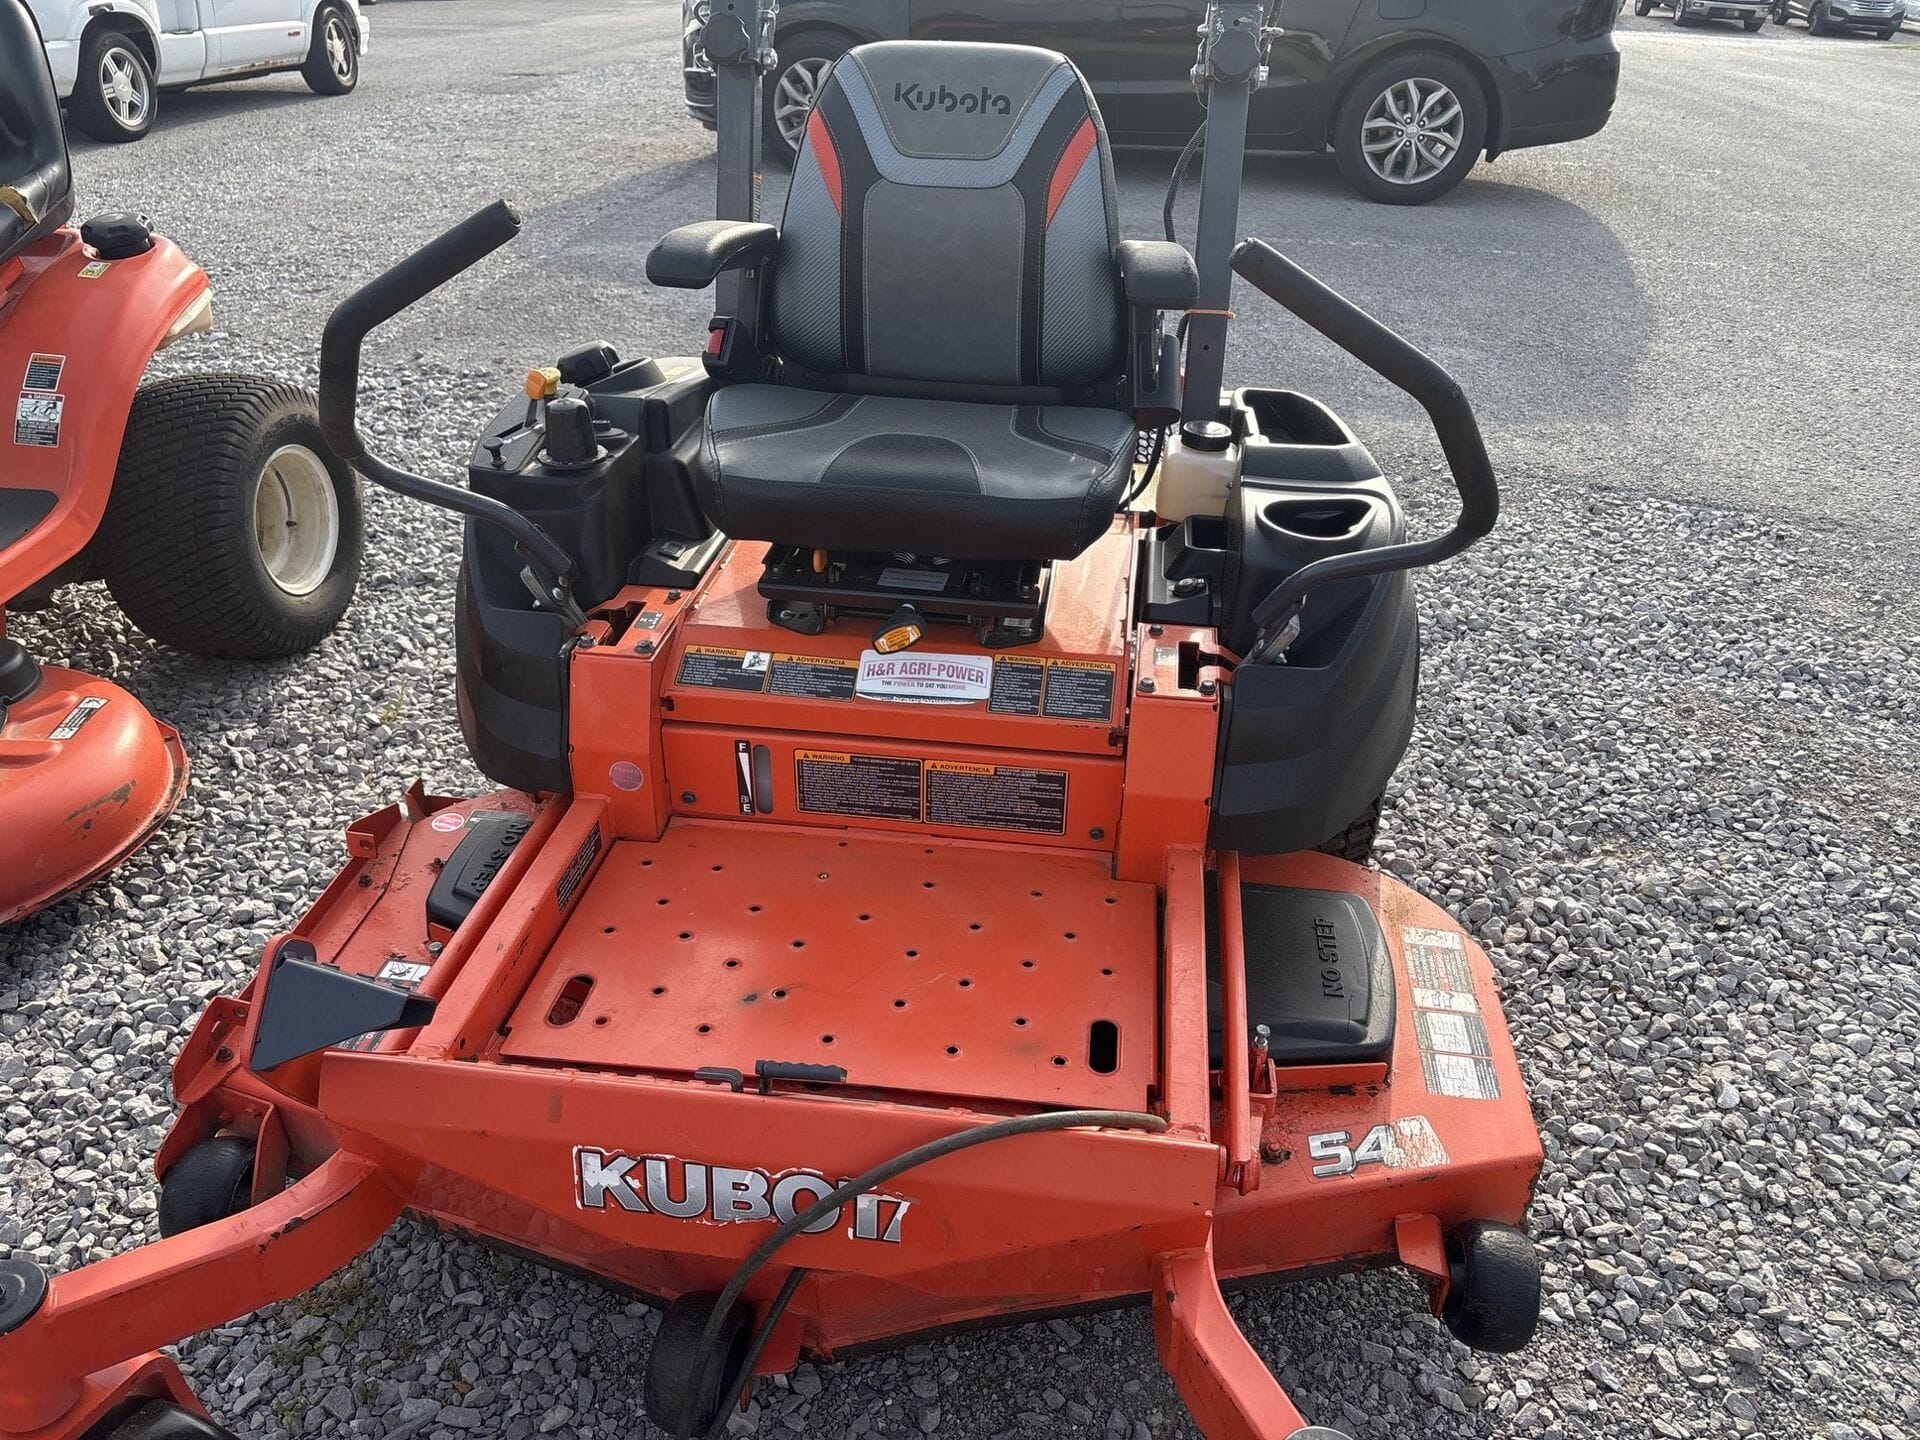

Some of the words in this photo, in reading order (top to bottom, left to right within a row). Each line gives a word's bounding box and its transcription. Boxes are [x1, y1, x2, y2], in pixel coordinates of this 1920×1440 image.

[894, 82, 1011, 115] Kubota
[704, 648, 738, 656] WARNING
[796, 657, 846, 666] ADVERTENCIA
[1061, 661, 1112, 669] ADVERTENCIA
[866, 661, 896, 677] H&R
[900, 661, 984, 684] AGRI-POWER
[739, 743, 746, 751] F
[811, 754, 845, 762] WARNING
[940, 764, 991, 773] ADVERTENCIA
[743, 804, 751, 813] E
[501, 822, 529, 847] NO
[1312, 913, 1339, 962] STEP
[1321, 966, 1344, 998] NO
